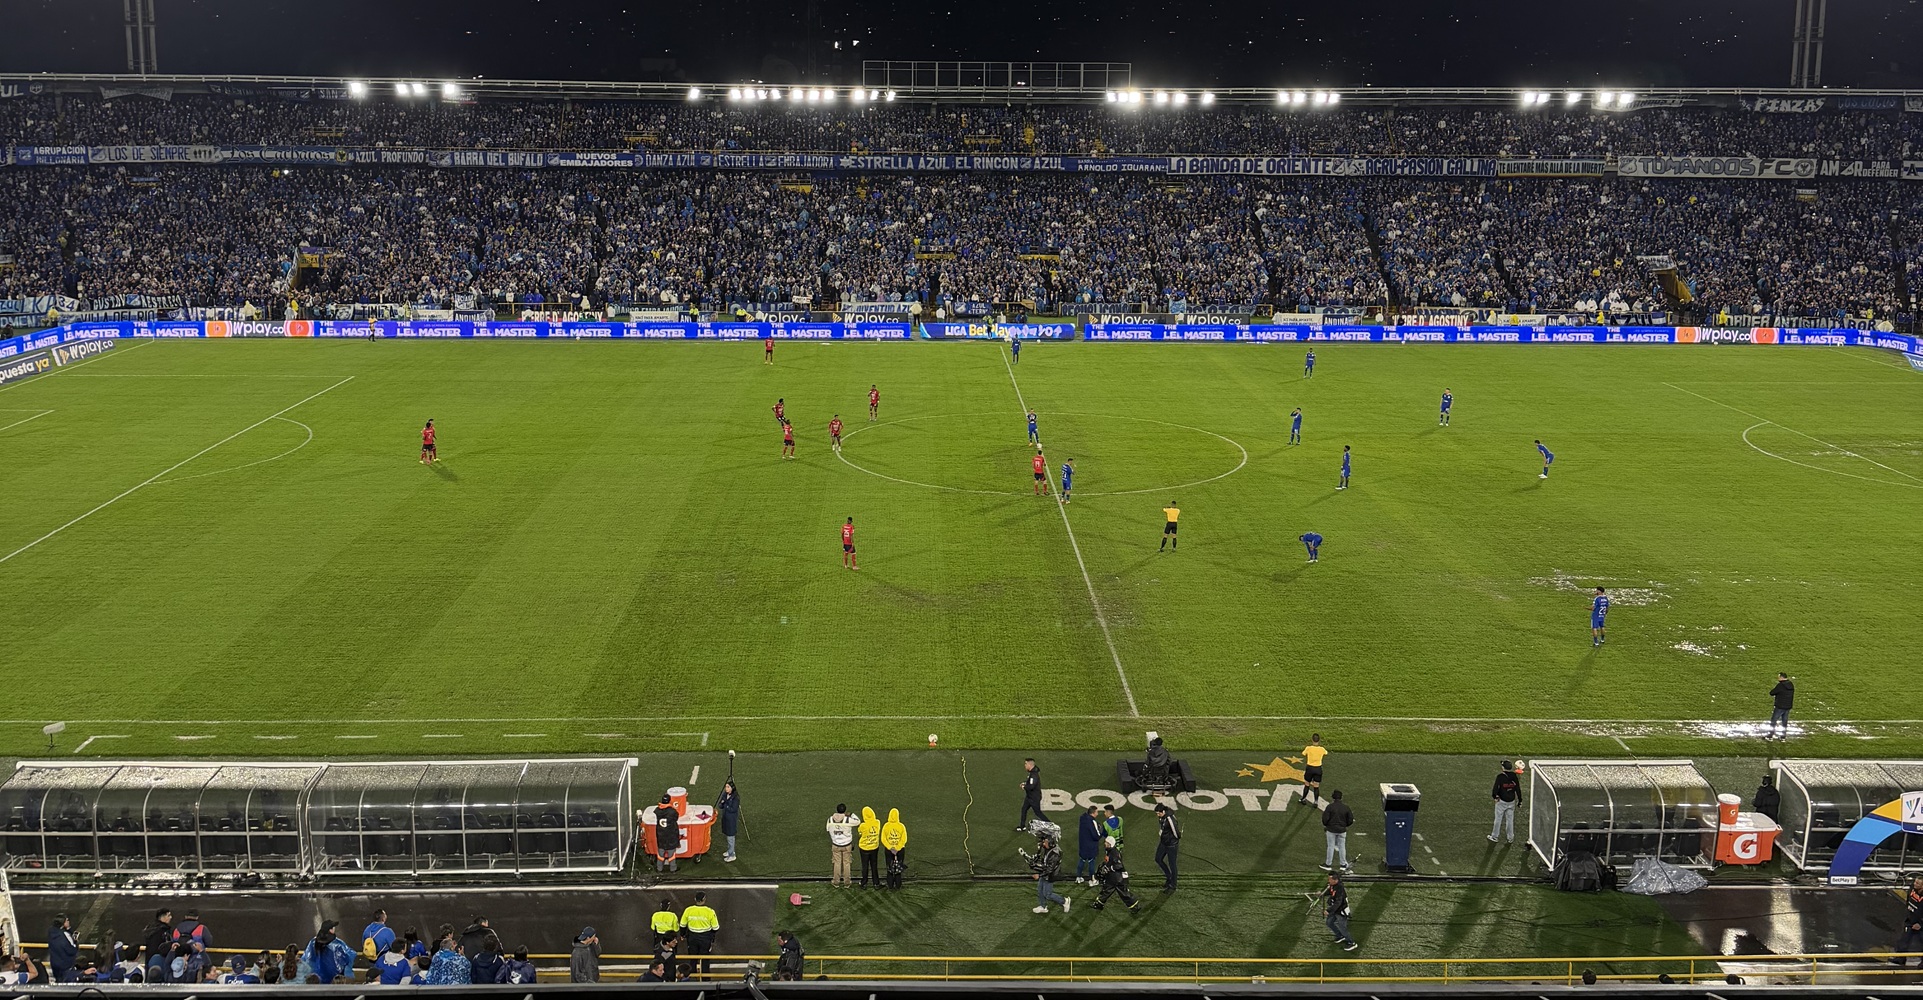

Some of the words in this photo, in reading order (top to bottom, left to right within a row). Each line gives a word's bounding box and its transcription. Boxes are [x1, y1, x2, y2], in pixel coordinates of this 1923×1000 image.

[0, 84, 24, 98] UL
[1754, 97, 1826, 113] PINZAS
[107, 147, 128, 161] LOS
[132, 147, 146, 161] DE
[150, 146, 191, 161] SIEMPRE
[355, 151, 377, 163] AZUL
[381, 151, 424, 163] PROFUNDO
[453, 152, 484, 166] BARRA
[487, 152, 505, 166] DEL
[645, 154, 674, 167] DANZA
[676, 154, 697, 166] AZUL
[718, 154, 764, 167] ESTRELLA
[850, 156, 914, 169] ESTRELLA
[918, 156, 950, 170] AZUL
[955, 157, 971, 169] EL
[1033, 157, 1065, 170] AZUL
[1167, 157, 1187, 173] LA
[1189, 157, 1240, 174] BANDA
[1243, 158, 1263, 174] DE
[1265, 158, 1331, 174] ORIENTE
[1446, 158, 1497, 176] GALLINA
[1499, 162, 1506, 173] TE
[1565, 162, 1573, 173] DE
[1573, 162, 1581, 173] LA
[1582, 162, 1605, 174] MUERTE
[1758, 159, 1795, 176] FC
[1871, 161, 1890, 169] PARA
[1863, 168, 1898, 177] DEFENDER
[81, 311, 110, 321] VILLA
[113, 311, 131, 321] DEL
[63, 324, 72, 332] THE
[75, 328, 120, 338] MASTER
[156, 328, 198, 337] MASTER
[233, 321, 284, 337] Wplay.co
[419, 328, 460, 337] MASTER
[495, 328, 536, 337] MASTER
[570, 328, 611, 337] MASTER
[945, 325, 967, 336] LIGA
[22, 334, 31, 342] THE
[645, 329, 685, 338] MASTER
[719, 329, 758, 338] MASTER
[792, 329, 831, 338] MASTER
[864, 329, 904, 338] MASTER
[1112, 331, 1151, 339] MASTER
[1184, 331, 1224, 339] MASTER
[1257, 331, 1297, 340] MASTER
[1330, 332, 1370, 340] MASTER
[1404, 332, 1444, 341] MASTER
[1478, 332, 1519, 341] MASTER
[1553, 333, 1594, 342] MASTER
[1628, 333, 1668, 342] MASTER
[1702, 326, 1751, 344] Wplay.co
[36, 335, 59, 350] MASTER
[1805, 335, 1846, 344] MASTER
[1877, 338, 1909, 351] MASTER
[69, 339, 114, 360] Wplay.co
[35, 358, 50, 373] ya
[659, 818, 668, 828] G
[1733, 833, 1758, 859] G
